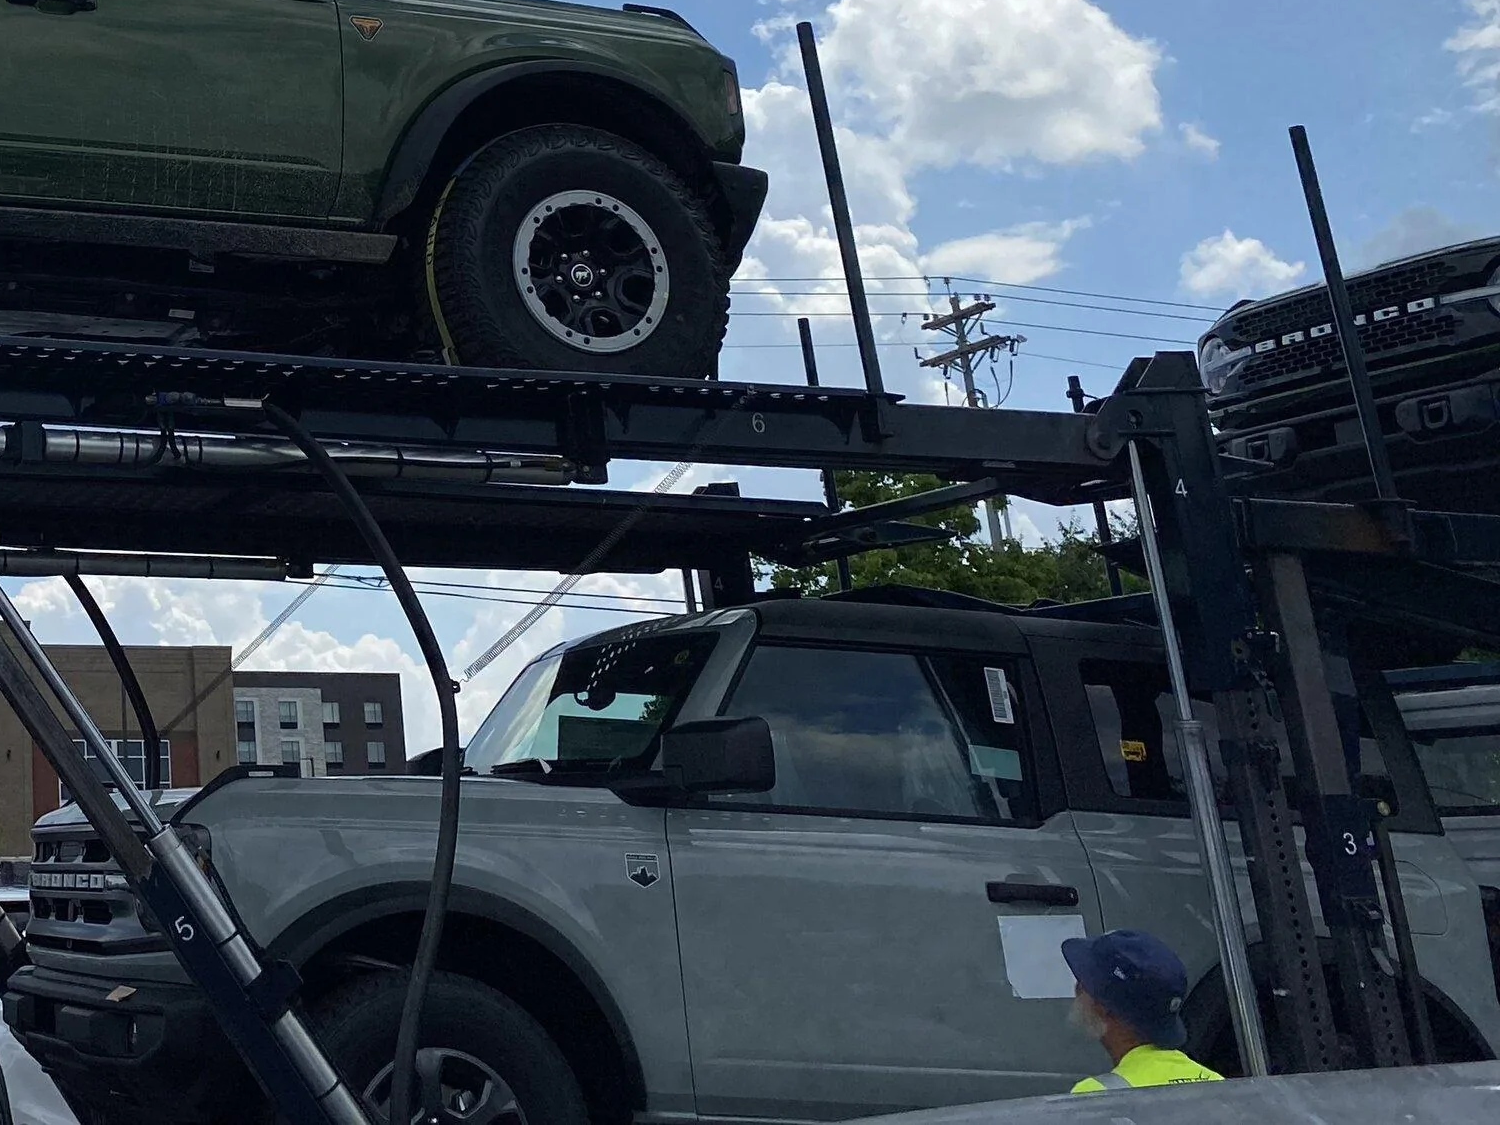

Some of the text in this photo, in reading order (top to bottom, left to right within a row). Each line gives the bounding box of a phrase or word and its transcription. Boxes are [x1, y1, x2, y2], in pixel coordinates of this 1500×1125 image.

[752, 412, 765, 432] 6
[1175, 478, 1187, 497] 4
[1343, 832, 1357, 855] 3
[175, 916, 194, 941] 5
